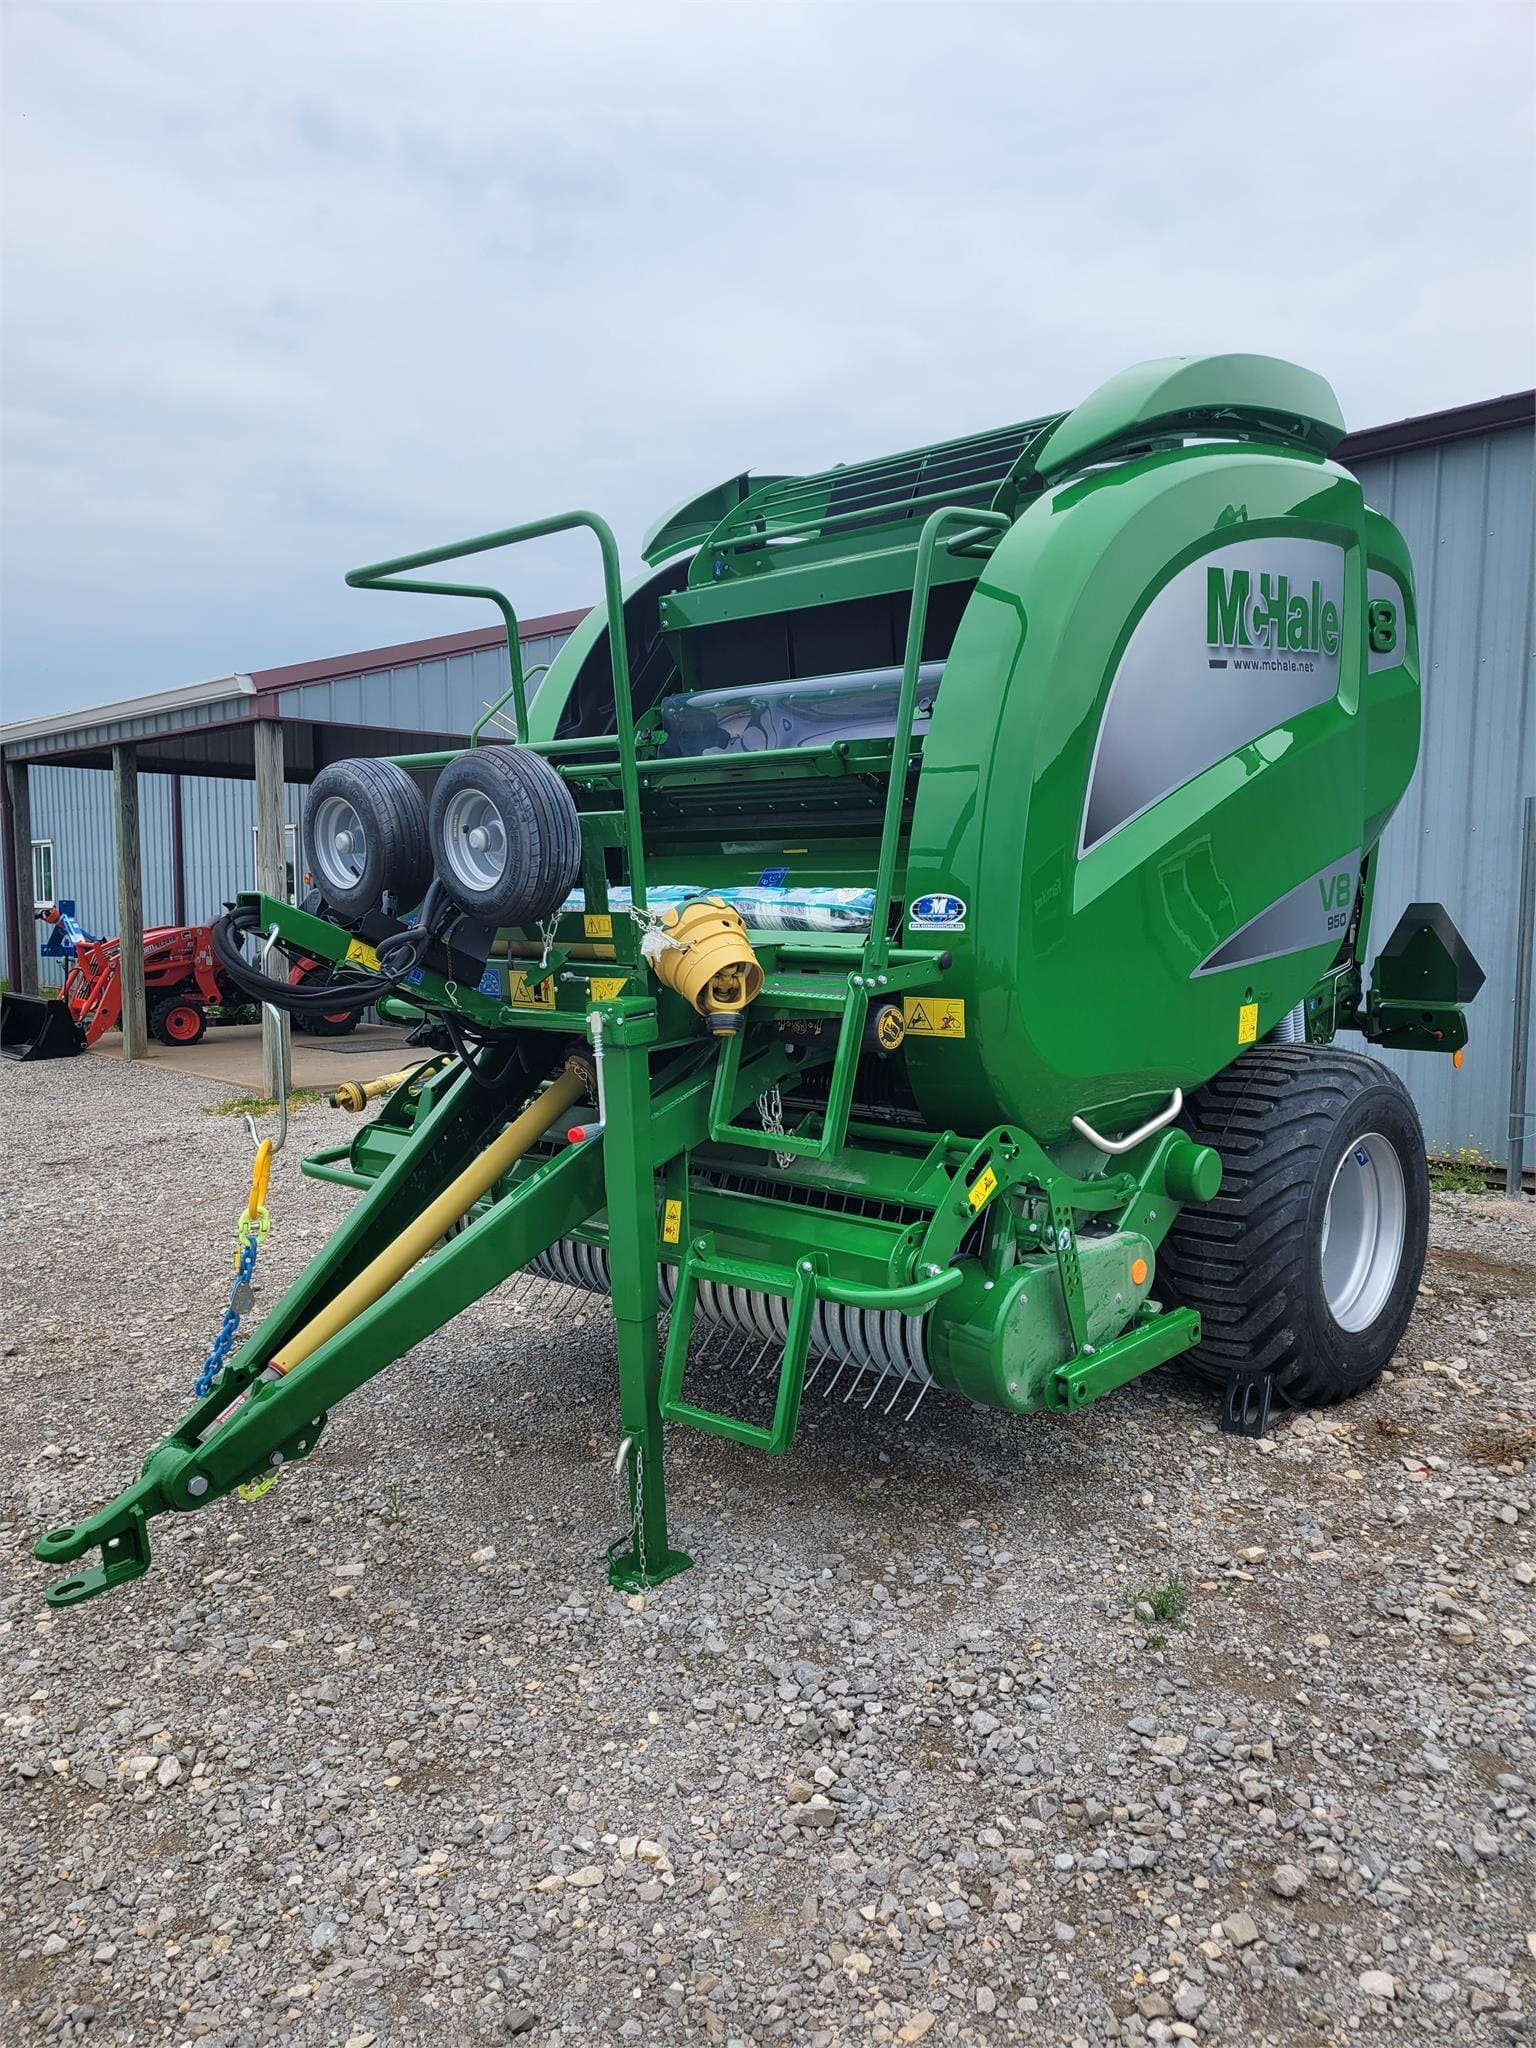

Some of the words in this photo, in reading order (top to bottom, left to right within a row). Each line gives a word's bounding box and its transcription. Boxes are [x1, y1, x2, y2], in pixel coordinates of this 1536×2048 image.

[1206, 566, 1339, 656] McHale
[1233, 659, 1314, 672] www.mchale.net
[1319, 873, 1350, 911] V8
[1327, 912, 1346, 930] 950
